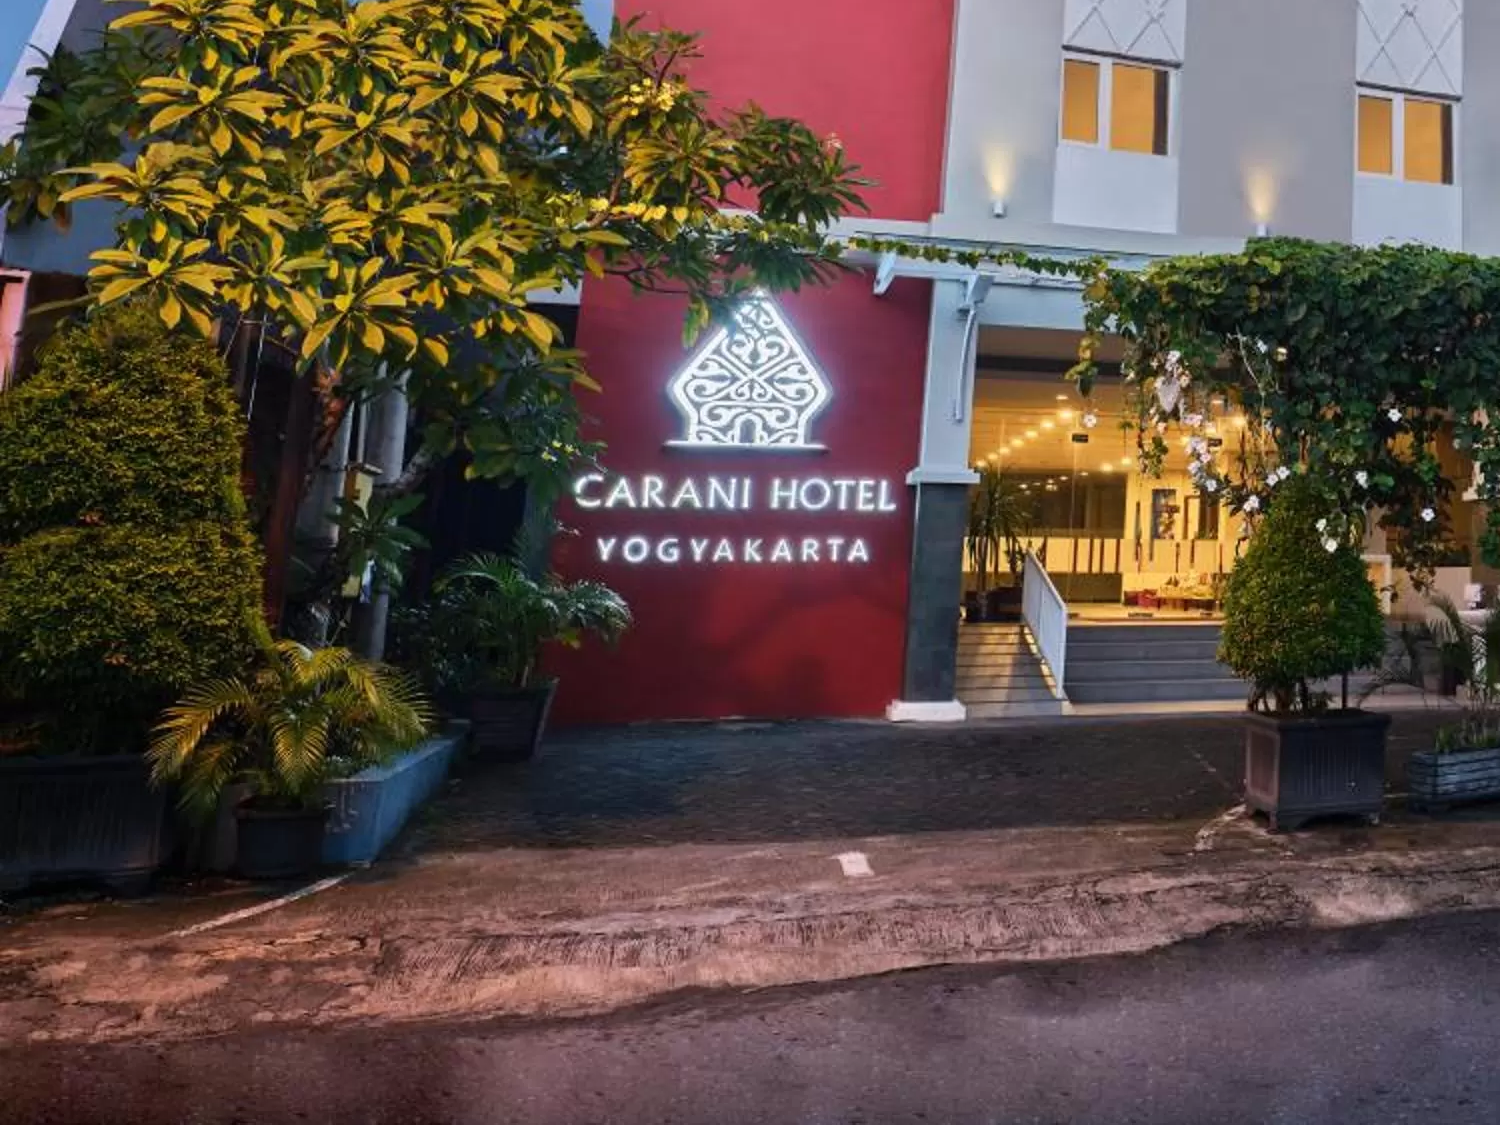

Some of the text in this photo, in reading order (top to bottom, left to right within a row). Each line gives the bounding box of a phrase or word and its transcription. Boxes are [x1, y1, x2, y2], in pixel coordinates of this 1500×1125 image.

[573, 474, 897, 512] CARANI HOTEL
[597, 536, 871, 563] YOGYAKARTA
